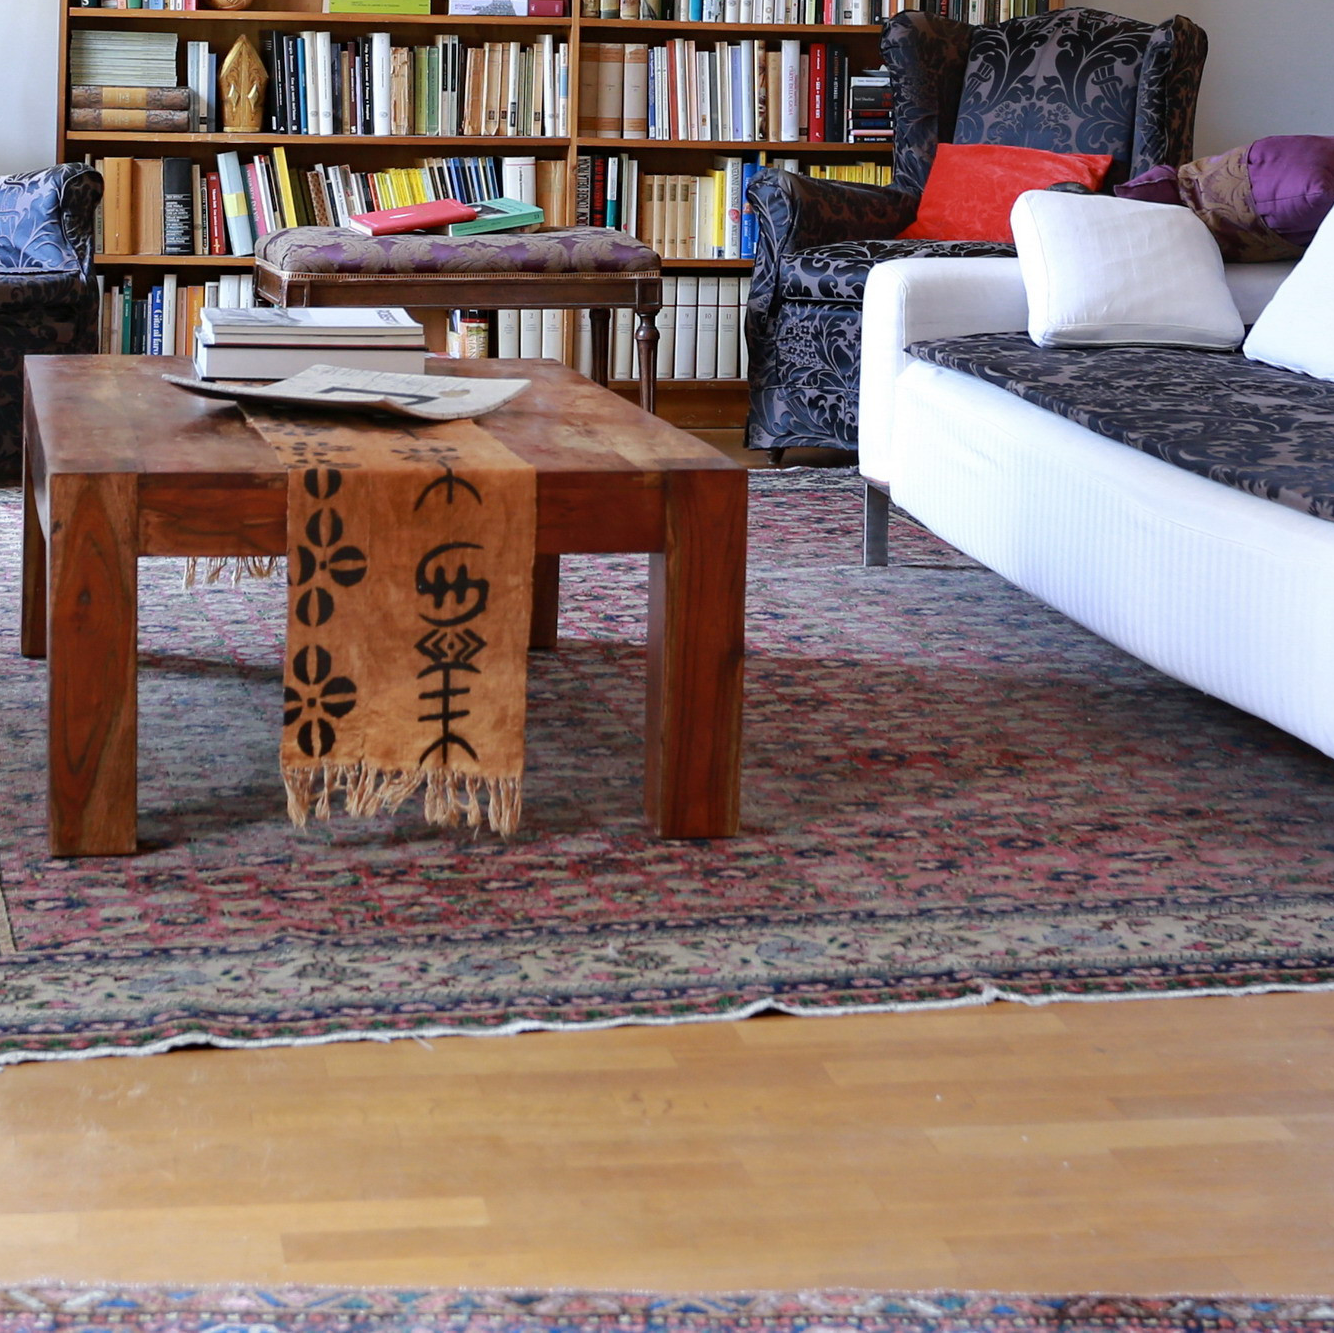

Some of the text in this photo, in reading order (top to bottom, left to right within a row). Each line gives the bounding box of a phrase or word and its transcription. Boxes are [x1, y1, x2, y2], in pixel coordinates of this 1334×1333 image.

[576, 158, 590, 174] PROVA
[576, 175, 590, 189] DELLA
[153, 309, 162, 327] Gita
[153, 328, 162, 337] al
[153, 338, 162, 355] faro
